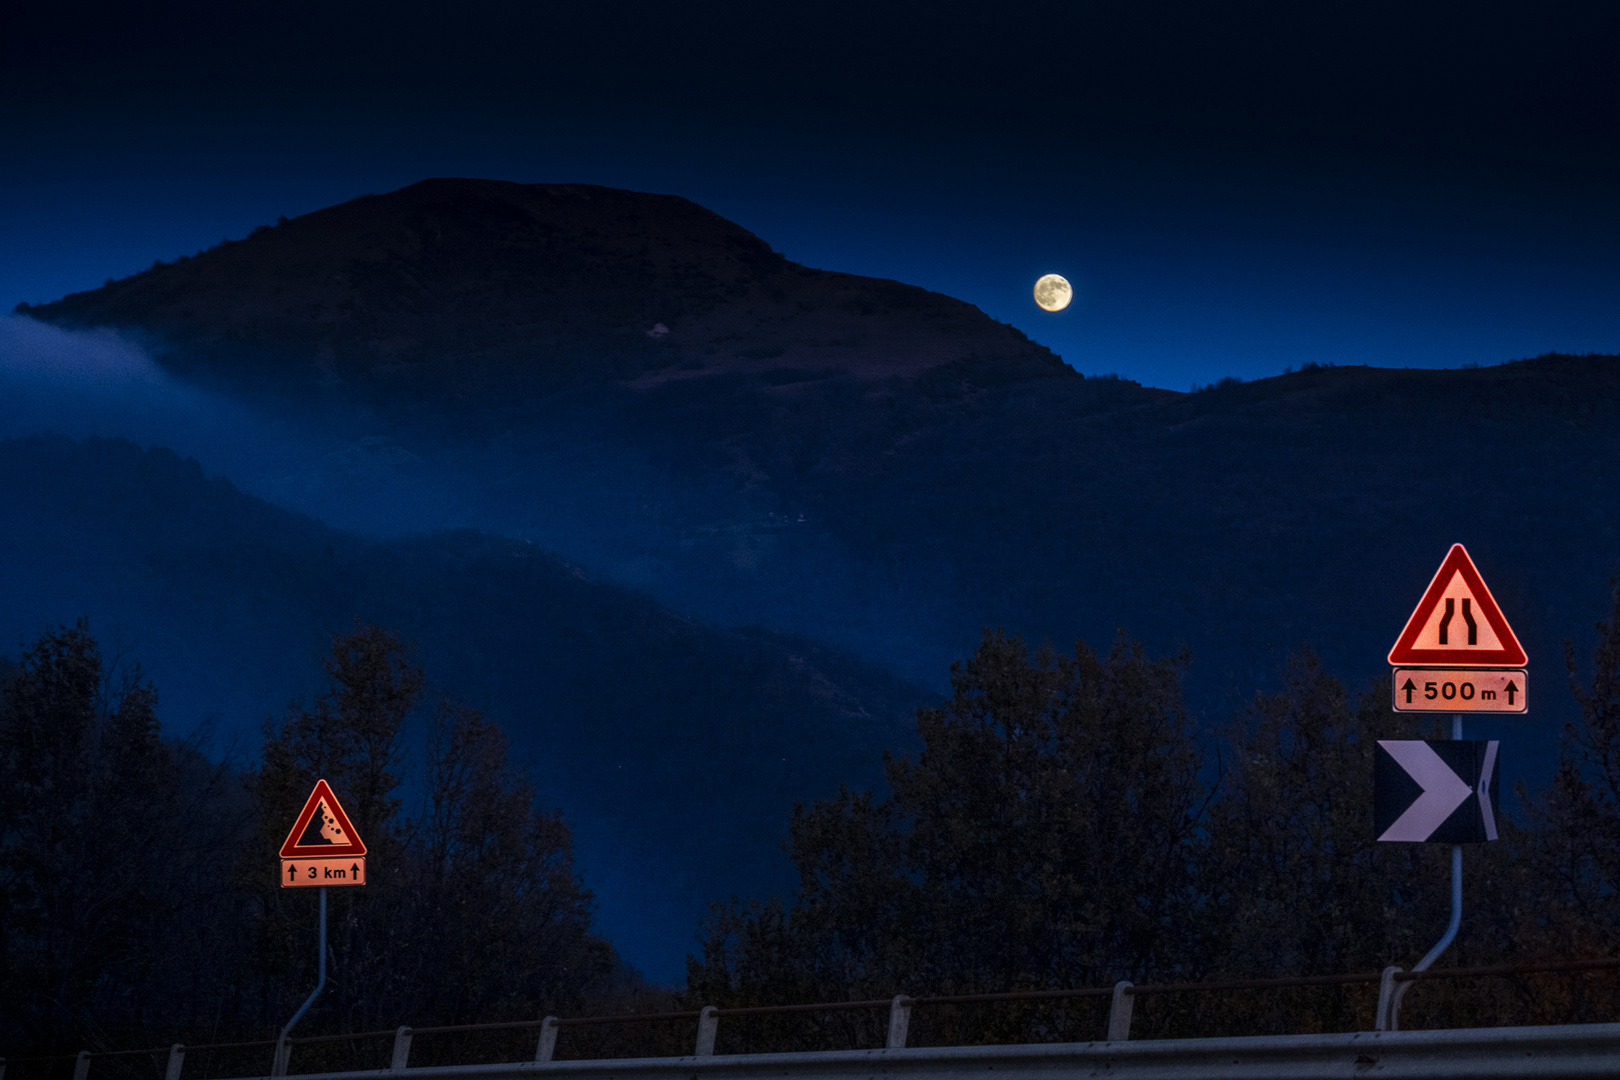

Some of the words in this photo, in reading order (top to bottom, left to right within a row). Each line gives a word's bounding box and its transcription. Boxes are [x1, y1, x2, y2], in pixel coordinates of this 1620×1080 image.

[1424, 682, 1475, 700] 500
[1481, 690, 1497, 700] m
[308, 867, 317, 878] 3
[324, 867, 346, 878] km
